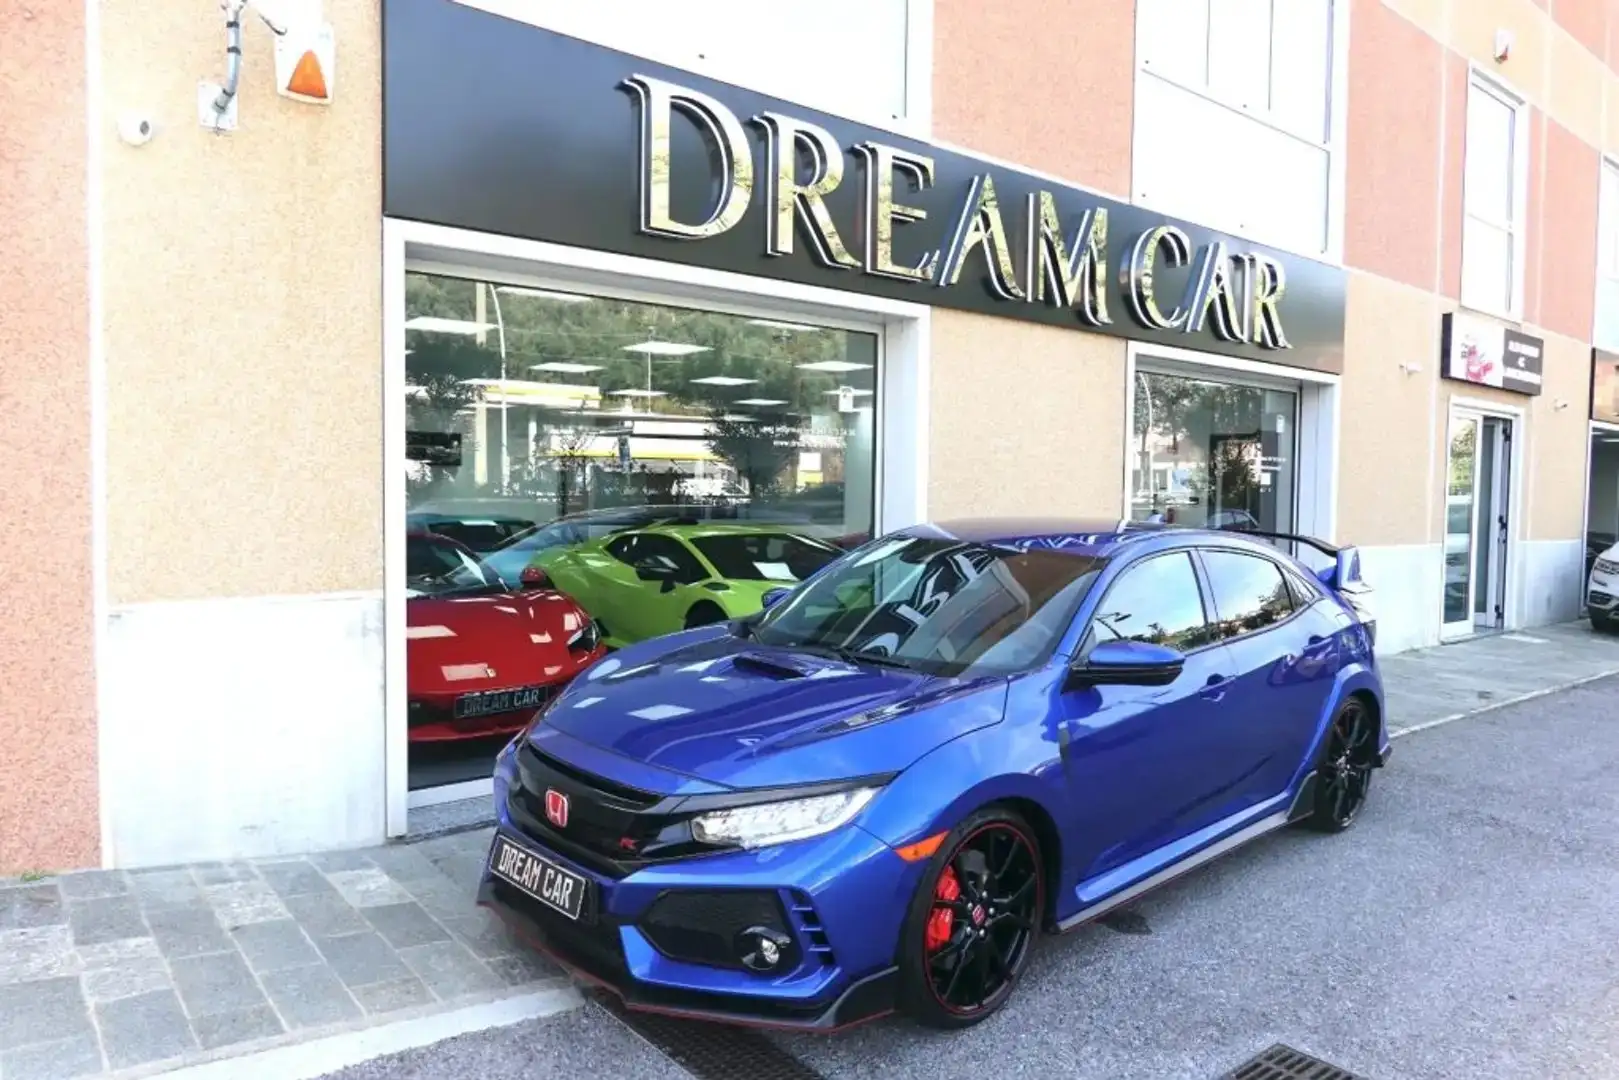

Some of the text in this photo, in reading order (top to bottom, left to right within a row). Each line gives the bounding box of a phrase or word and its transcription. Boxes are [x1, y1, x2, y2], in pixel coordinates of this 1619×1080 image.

[621, 74, 1292, 350] DREAM CAR
[463, 689, 539, 714] DREAM CAR
[499, 844, 573, 909] DREAM CAR
